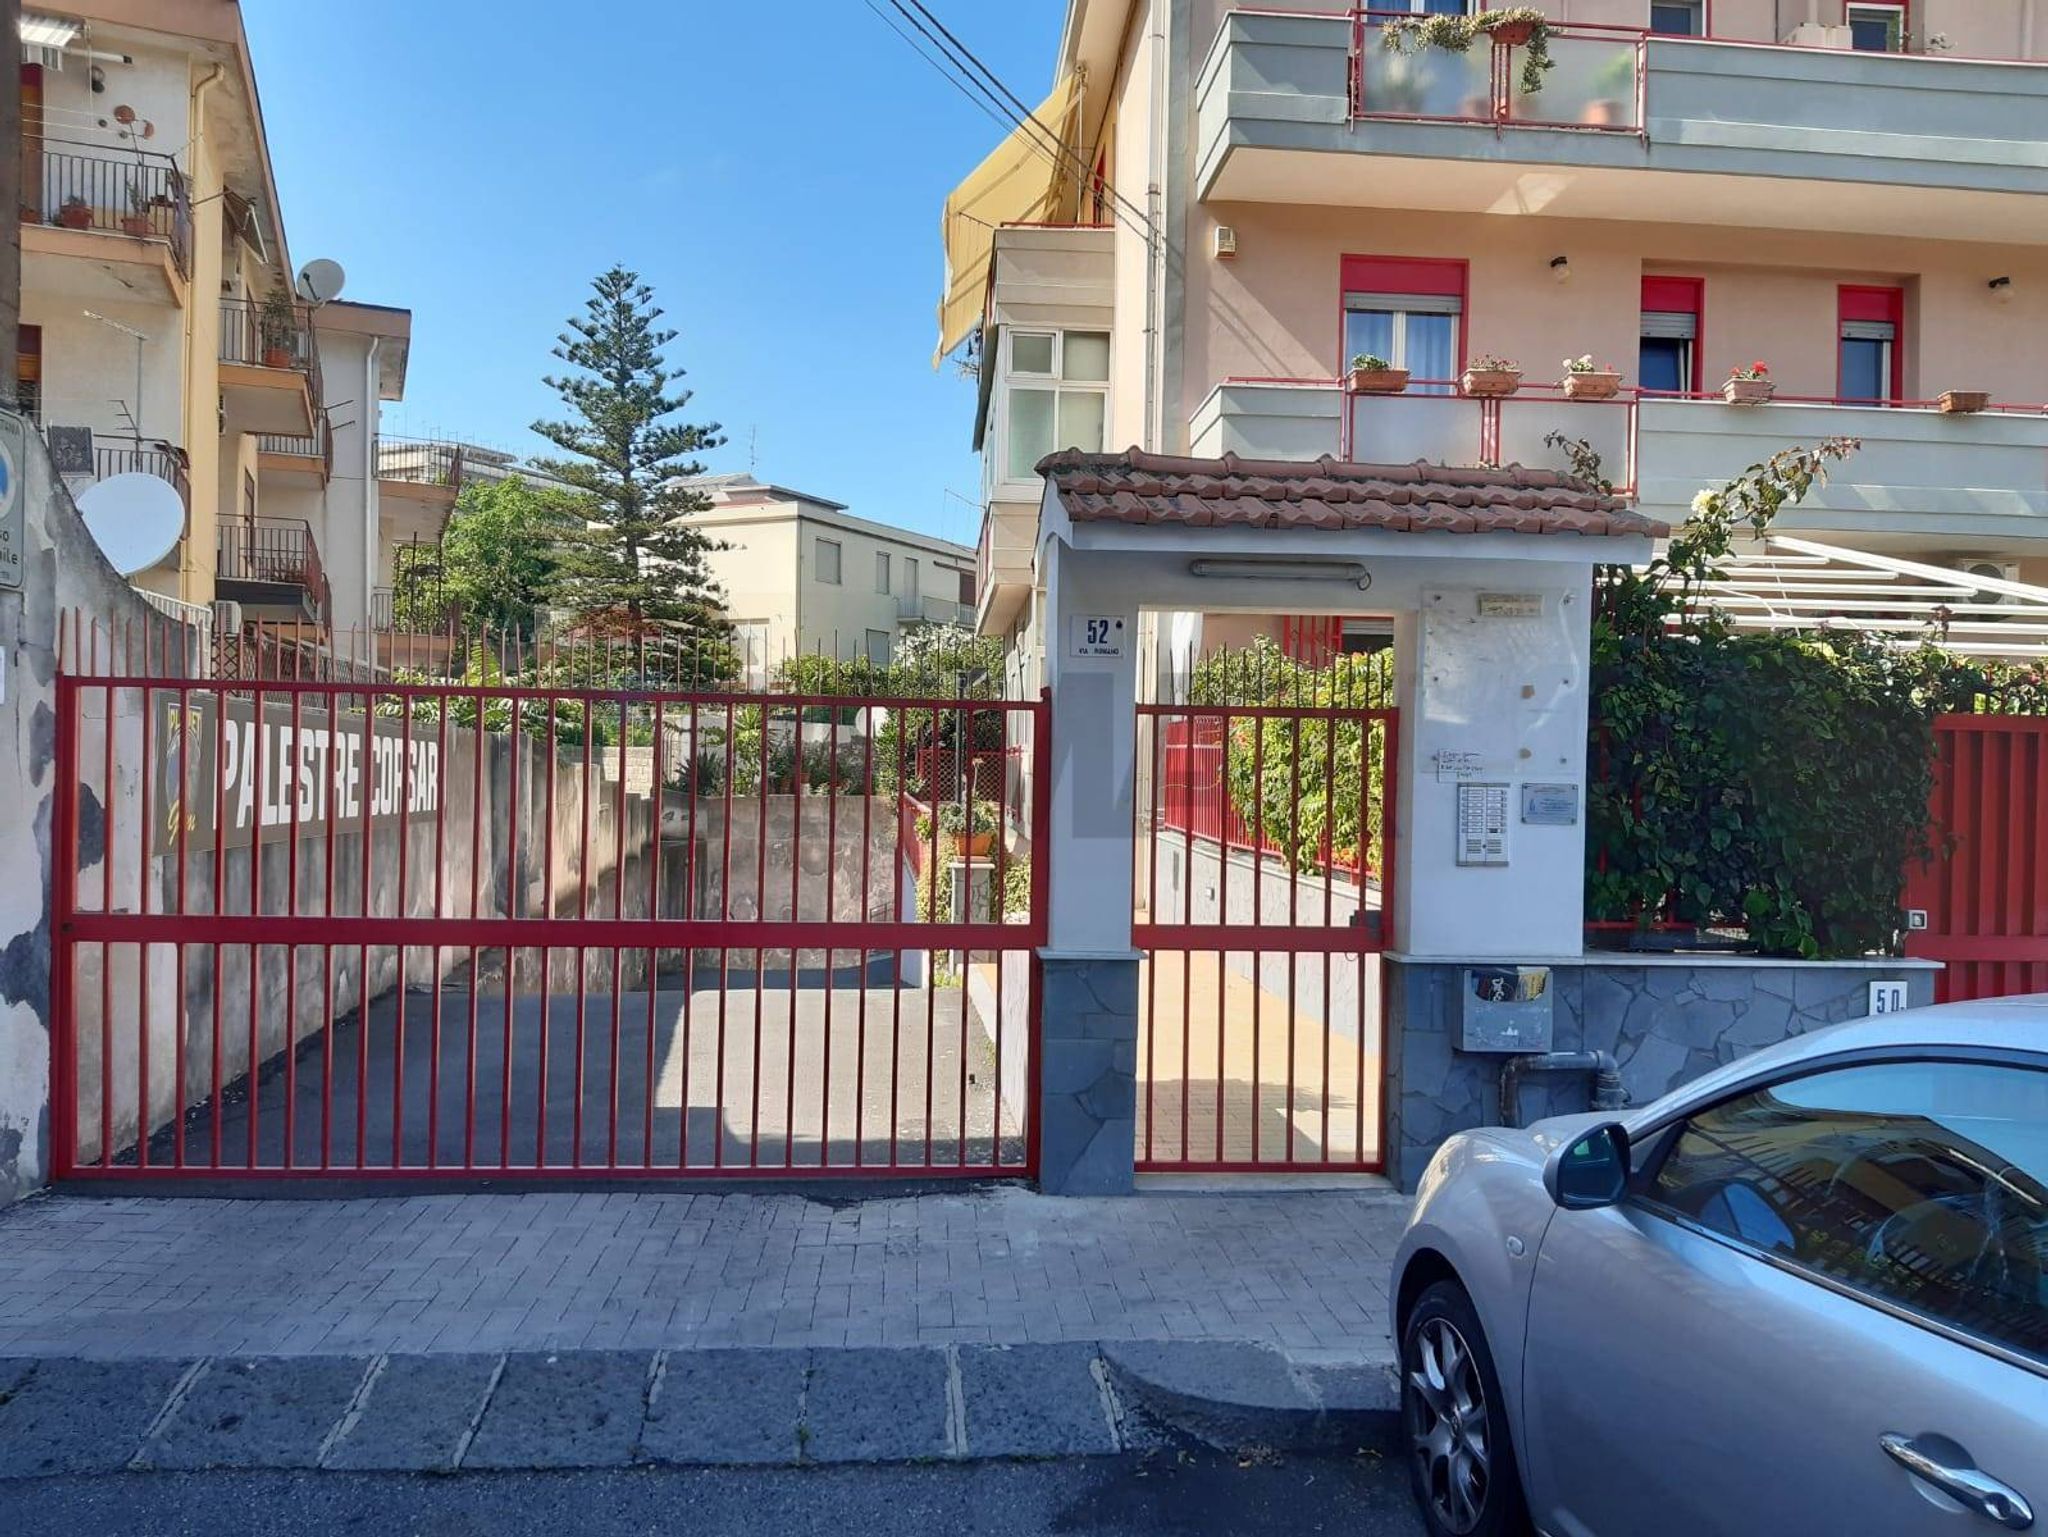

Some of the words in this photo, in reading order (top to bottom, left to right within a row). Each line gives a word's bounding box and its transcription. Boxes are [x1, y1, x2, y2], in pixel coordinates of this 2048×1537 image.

[1087, 619, 1109, 644] 52
[213, 718, 360, 830] PALESTRE
[1877, 988, 1900, 1013] 50
